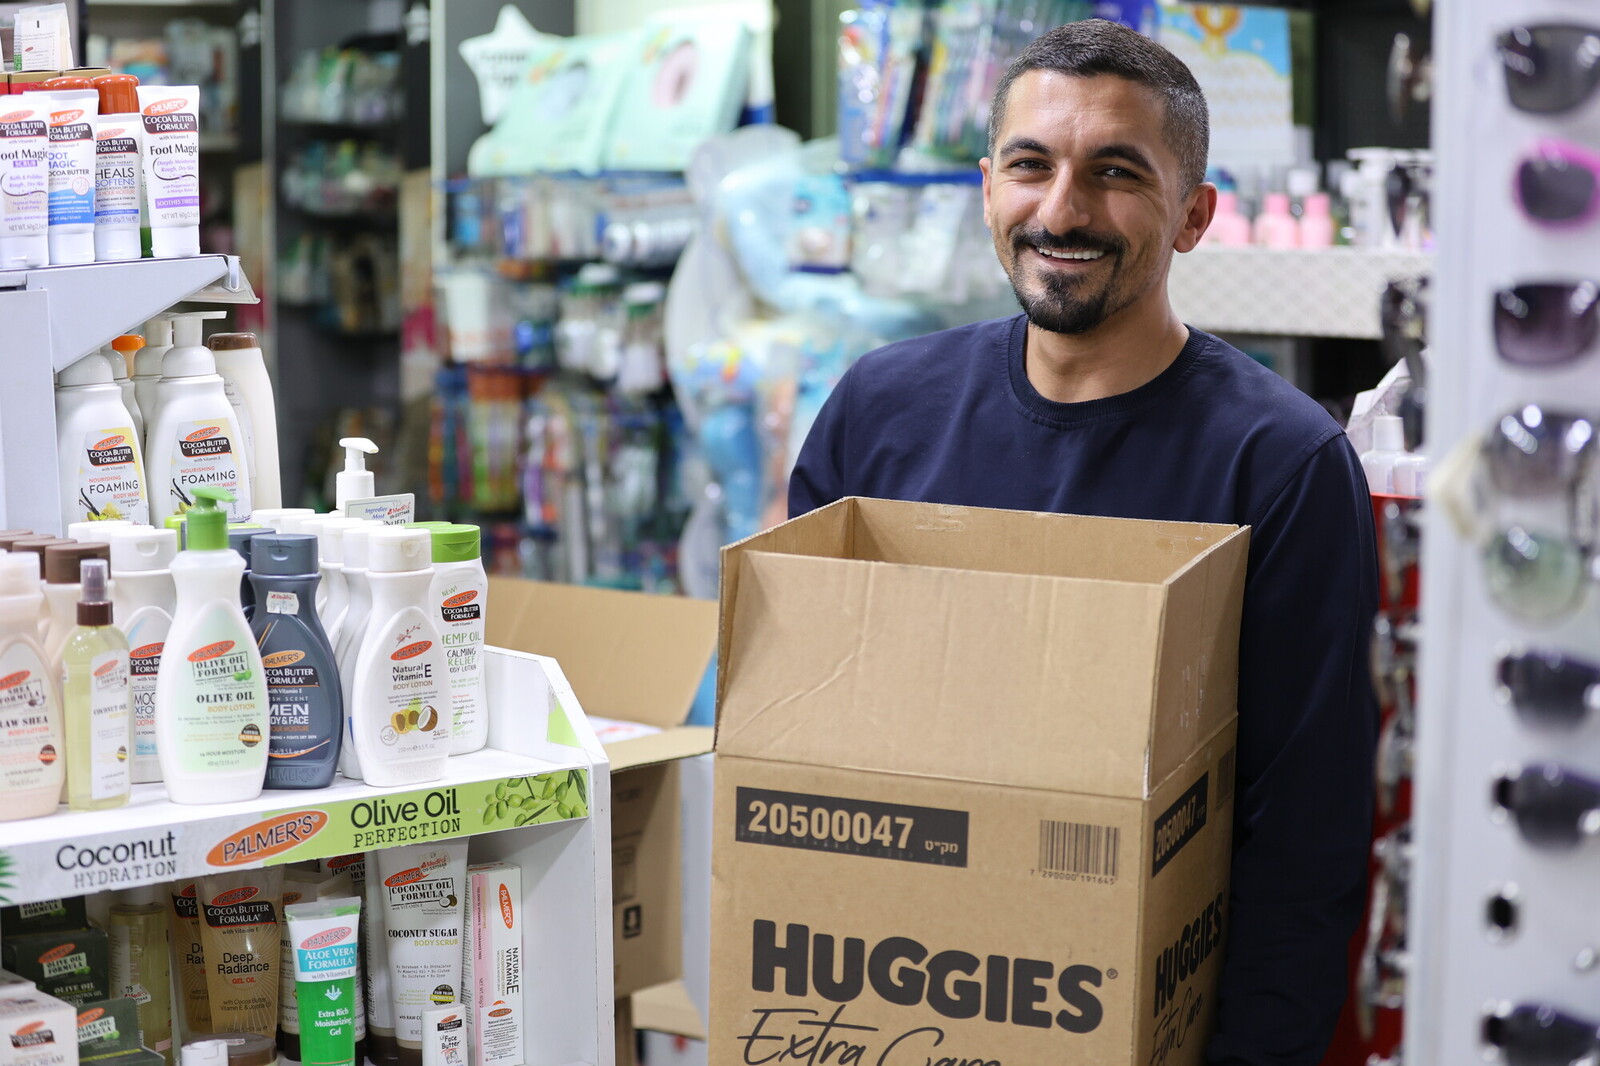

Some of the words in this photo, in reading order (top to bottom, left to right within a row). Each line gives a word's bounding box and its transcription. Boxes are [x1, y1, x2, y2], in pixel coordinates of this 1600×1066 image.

[145, 115, 172, 125] COCOA
[172, 115, 194, 124] BUTTER
[63, 124, 89, 133] BUTTER
[156, 122, 188, 132] FORMULA
[150, 144, 172, 156] Foot
[174, 142, 197, 156] Magic
[96, 167, 134, 180] HEALS
[96, 178, 135, 188] SOFTENS
[90, 450, 112, 458] COCOA
[191, 446, 221, 455] FORMULA
[99, 456, 125, 464] FORMULA
[181, 466, 215, 474] NOURISHING
[88, 475, 121, 483] NOURISHING
[181, 469, 236, 485] FOAMING
[89, 479, 139, 494] FOAMING
[441, 585, 458, 597] NEW!
[450, 612, 474, 621] FORMULA
[469, 630, 482, 642] OIL
[264, 652, 299, 666] PALMER'S
[446, 647, 477, 659] CALMING
[196, 658, 227, 670] OLIVE
[229, 655, 246, 664] OIL
[447, 655, 475, 667] RELIEF
[197, 663, 246, 678] FORMULA
[284, 668, 314, 677] BUTTER
[392, 662, 423, 674] Natural
[424, 664, 432, 678] E
[392, 671, 424, 682] Vitamin
[392, 682, 410, 691] BODY
[410, 680, 433, 688] LOTION
[196, 692, 233, 704] OLIVE
[236, 691, 255, 701] OIL
[207, 705, 228, 713] BODY
[229, 703, 256, 712] LOTION
[22, 715, 48, 726] SHEA
[289, 715, 309, 725] FACE
[350, 801, 420, 830] Olive
[424, 788, 462, 818] Oil
[748, 800, 914, 849] 20500047
[352, 818, 462, 849] PERFECTION
[56, 830, 178, 871] Coconut
[73, 860, 178, 889] HYDRATION
[1030, 869, 1035, 877] 7
[1042, 870, 1077, 881] 290000
[1080, 875, 1115, 885] 191645
[391, 882, 434, 895] COCONUT
[435, 881, 451, 890] OIL
[217, 888, 254, 904] PALMER'S
[400, 890, 444, 902] FORMULA
[24, 904, 59, 916] FORMULA
[207, 907, 237, 916] COCOA
[239, 904, 270, 914] BUTTER
[500, 889, 512, 927] PALMER'S
[219, 914, 259, 924] FORMULA
[307, 928, 347, 948] PALMER'S
[388, 929, 428, 938] COCONUT
[429, 928, 458, 938] SUGAR
[414, 939, 434, 947] BODY
[436, 938, 459, 946] SCRUB
[223, 952, 254, 964] Deep
[305, 951, 330, 961] ALOE
[332, 946, 354, 956] VERA
[1153, 891, 1223, 1019] HUGGIES
[46, 958, 67, 968] OLIVE
[70, 954, 82, 962] OIL
[308, 957, 353, 970] FORMULA
[512, 947, 520, 984] NATURAL
[48, 962, 83, 975] FORMULA
[217, 962, 270, 975] Radiance
[231, 977, 244, 985] GEL
[311, 972, 326, 980] with
[53, 984, 80, 994] OLIVE
[80, 982, 95, 990] OIL
[506, 984, 520, 995] E
[318, 1010, 335, 1018] Extra
[336, 1007, 349, 1016] Rich
[98, 1019, 110, 1027] OIL
[314, 1017, 352, 1028] Moisturizing
[329, 1028, 342, 1036] Gel
[737, 1003, 879, 1066] Extra
[444, 1035, 457, 1043] Face
[441, 1041, 460, 1050] Butter
